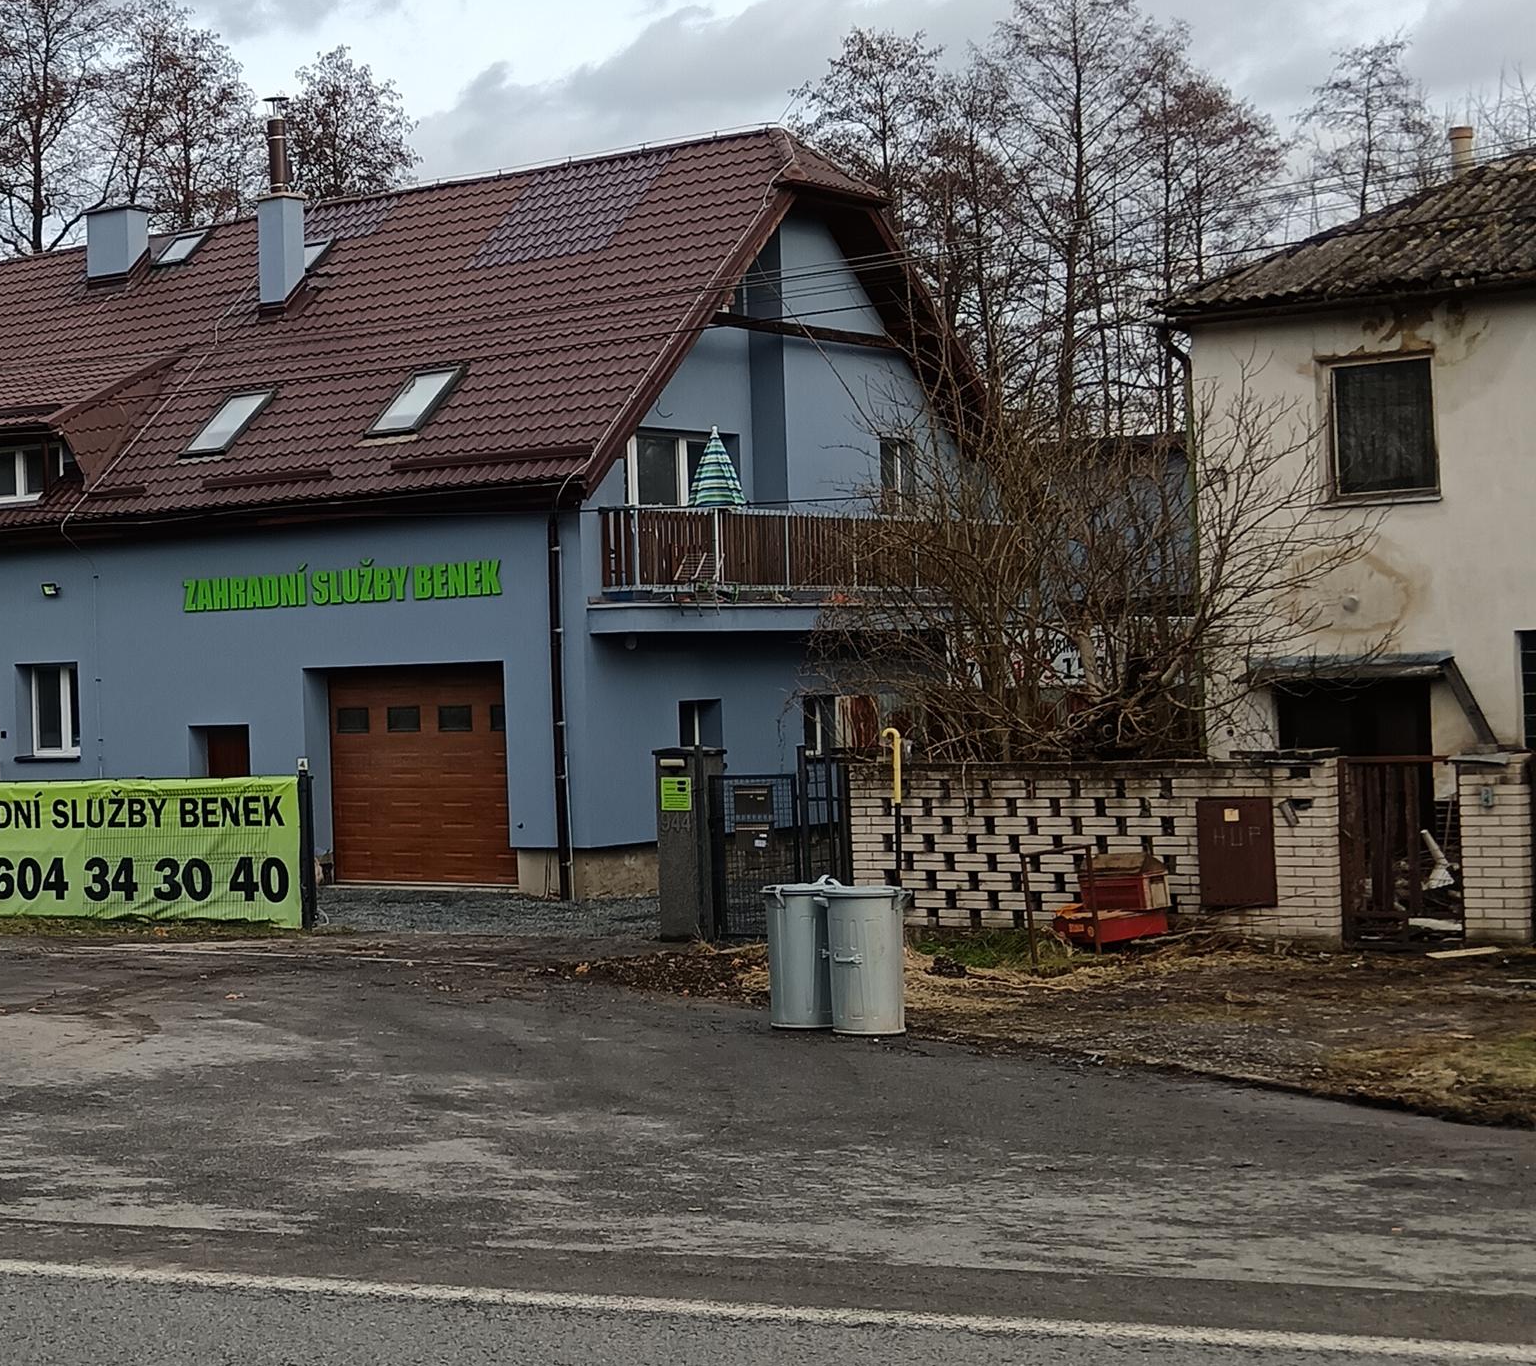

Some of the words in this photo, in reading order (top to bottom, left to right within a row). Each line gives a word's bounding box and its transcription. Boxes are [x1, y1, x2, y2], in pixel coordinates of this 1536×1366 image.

[184, 562, 308, 612] ZAHRADNÍ
[312, 557, 410, 605] SLUŽBY
[413, 559, 502, 600] BENEK
[51, 789, 166, 829] SLUŽBY
[179, 795, 285, 828] BENEK
[1214, 826, 1261, 846] HUP
[83, 856, 138, 902] 34
[153, 857, 213, 902] 30
[229, 856, 290, 903] 40
